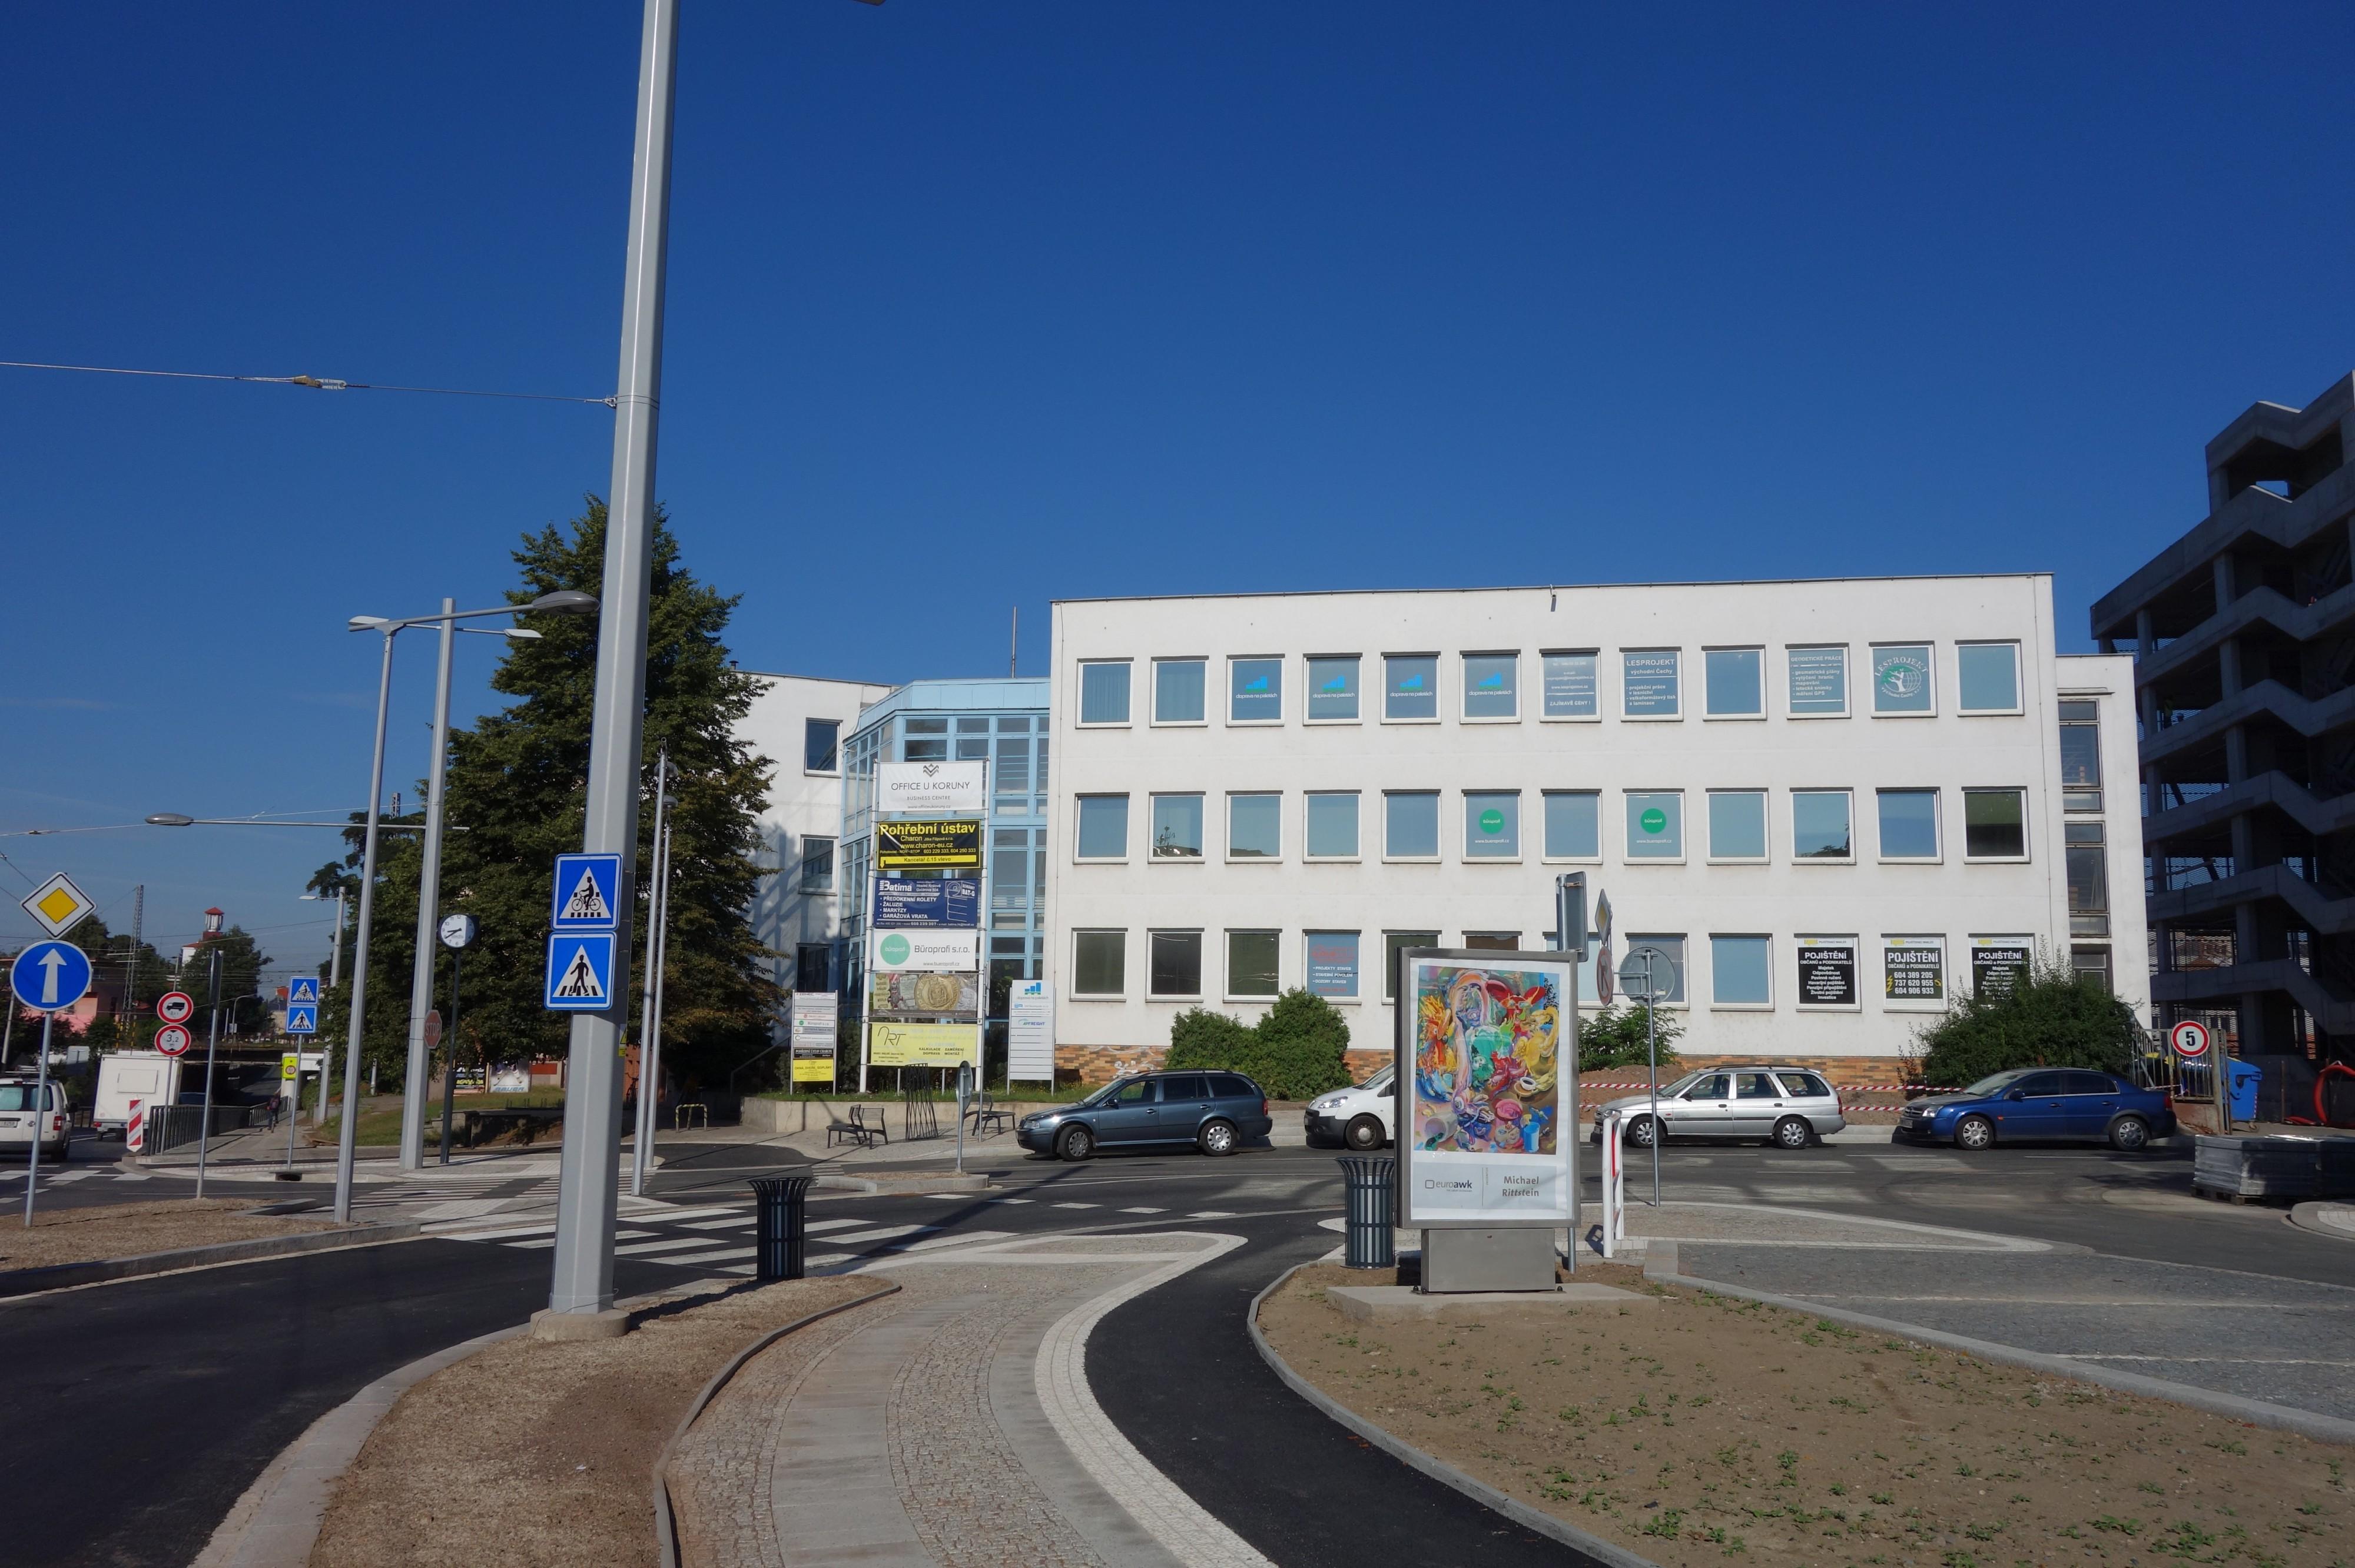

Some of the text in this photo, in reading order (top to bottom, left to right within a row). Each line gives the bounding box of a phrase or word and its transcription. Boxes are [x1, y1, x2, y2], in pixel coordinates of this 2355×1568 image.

[891, 782, 921, 790] OFFICE
[932, 781, 970, 790] KORUNY
[880, 822, 976, 835] Pohřební ústav
[880, 880, 912, 892] Batima
[914, 945, 950, 954] Büroprofi
[1805, 951, 1847, 959] POJIŠTĚNÍ
[1888, 951, 1938, 962] POJIŠTĚNÍ
[1978, 951, 2022, 959] POJIŠTĚNÍ
[425, 1022, 440, 1037] STOP
[2185, 1031, 2195, 1047] 5
[1436, 1180, 1472, 1189] euroawk
[1504, 1176, 1539, 1184] Michael
[1502, 1189, 1539, 1197] Rittstein
